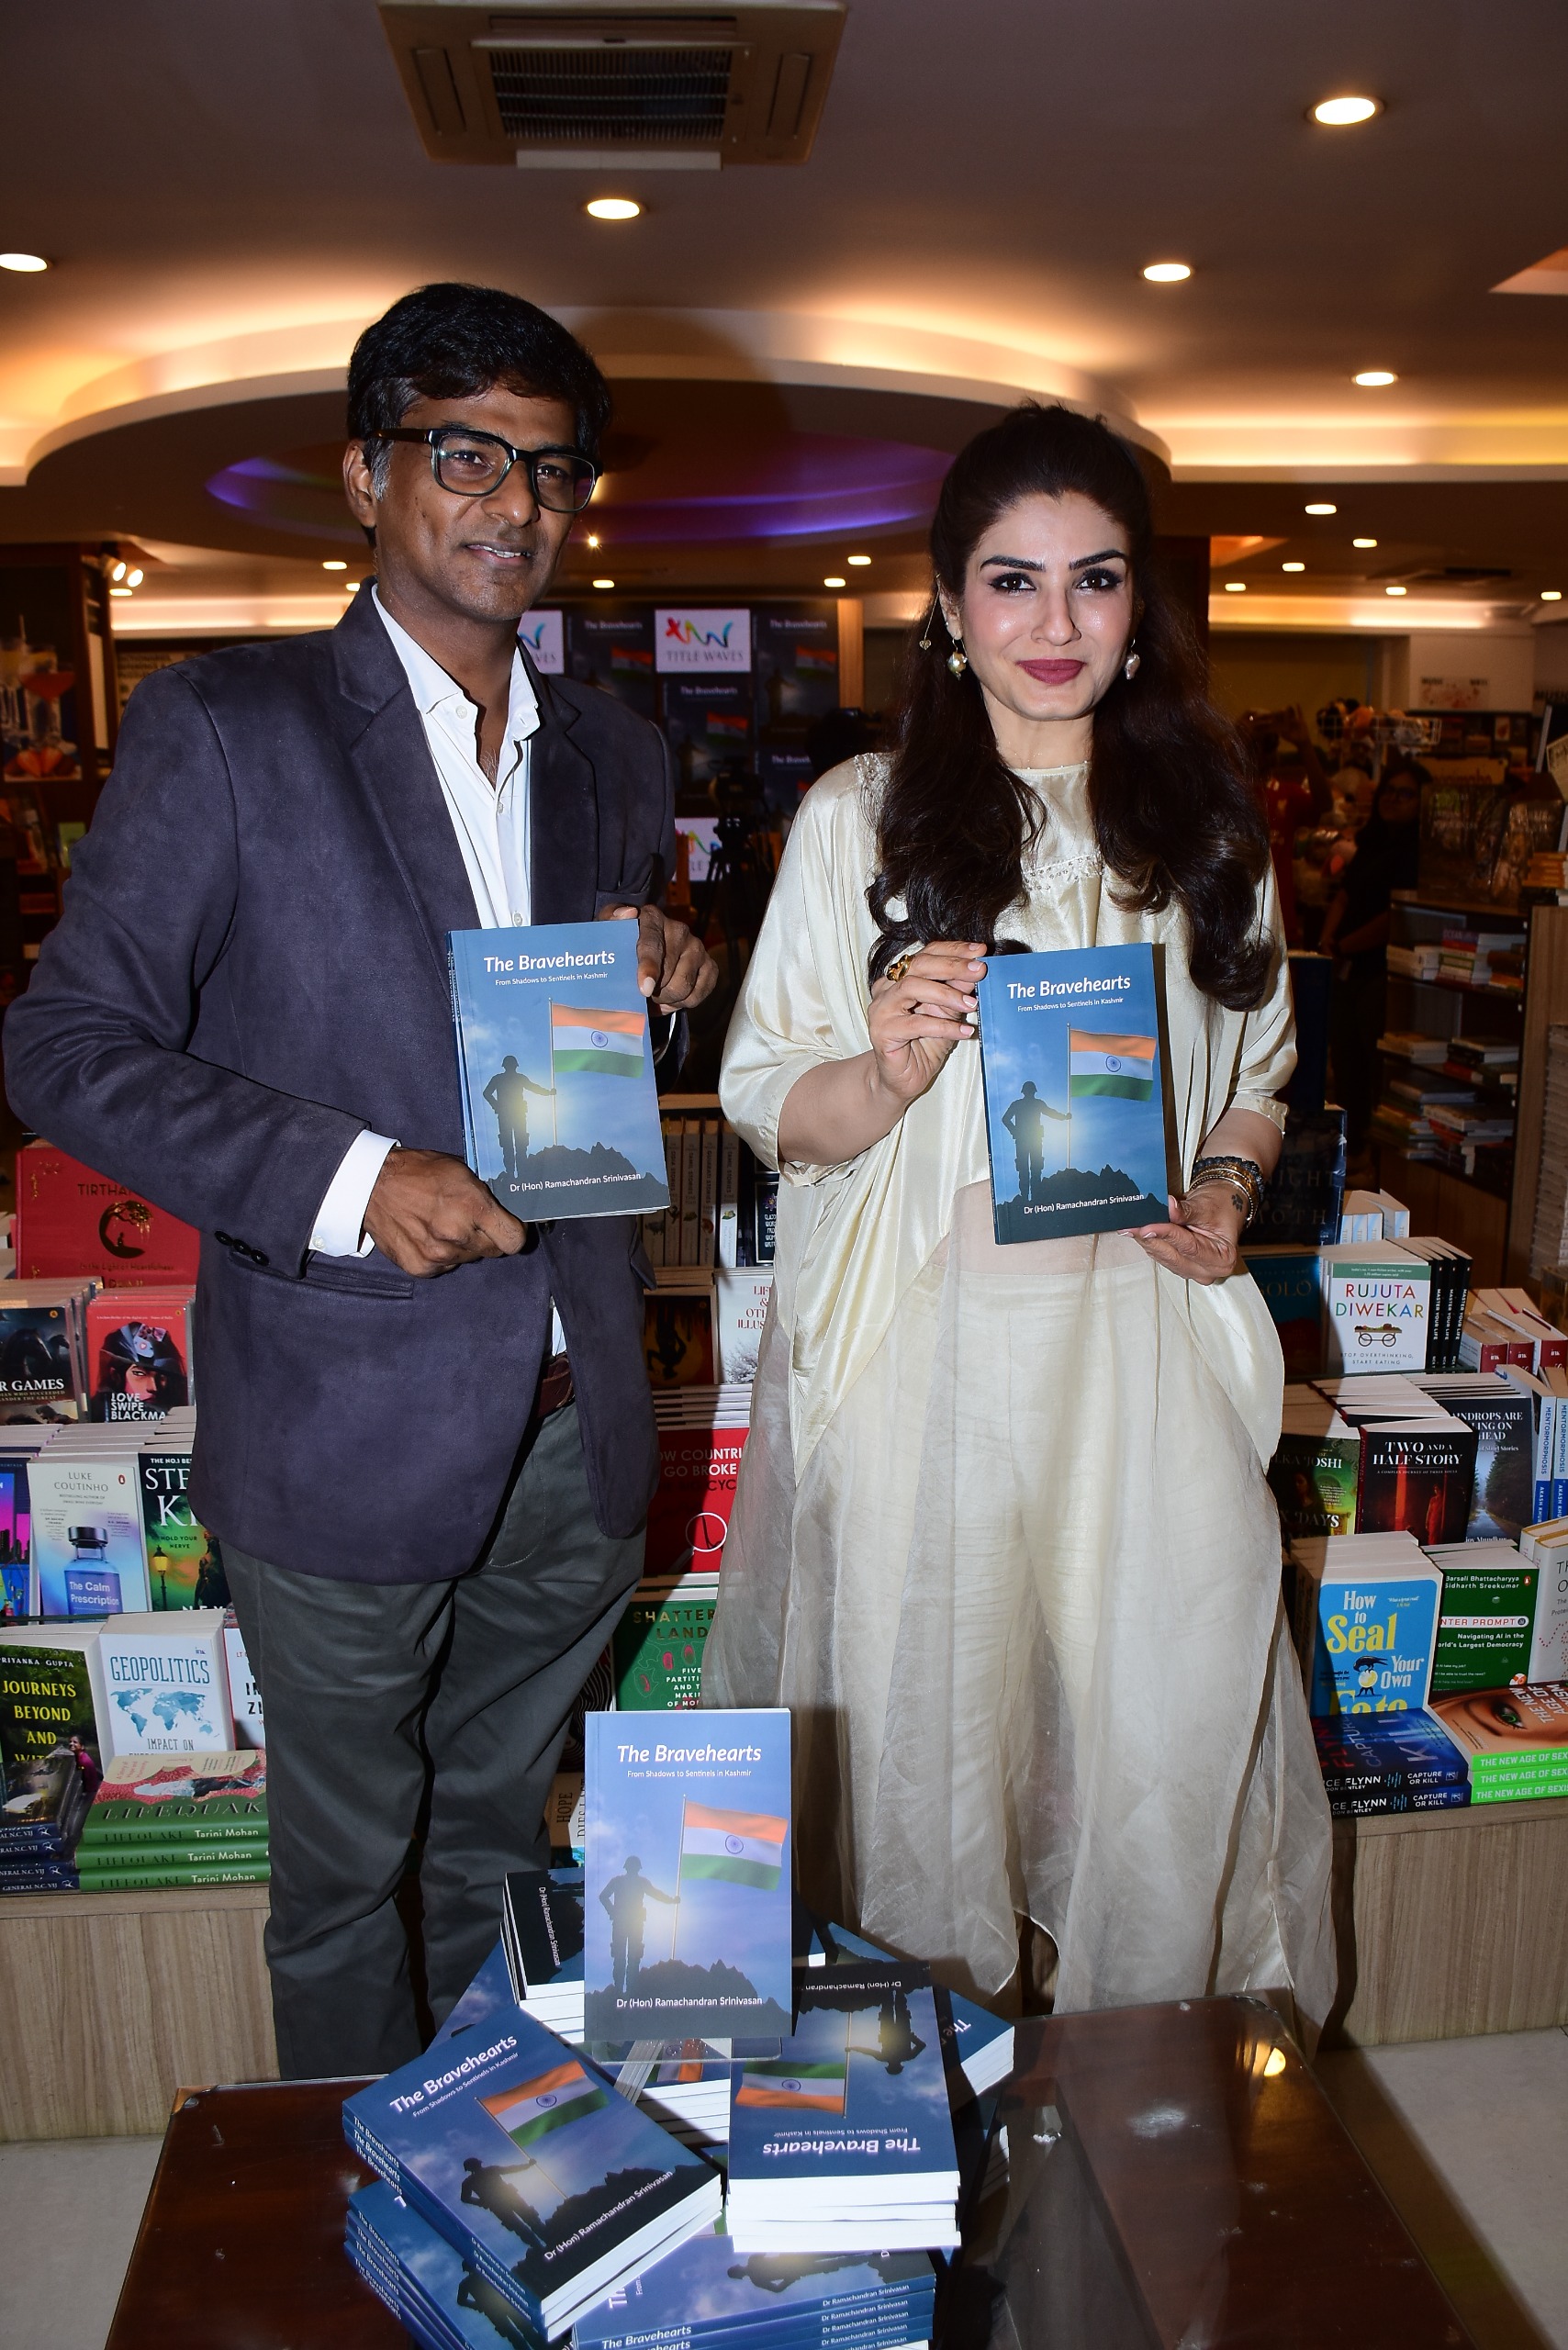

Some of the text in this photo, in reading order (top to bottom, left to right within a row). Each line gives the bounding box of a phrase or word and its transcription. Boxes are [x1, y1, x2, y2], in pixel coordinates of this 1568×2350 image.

[667, 650, 744, 662] TITLE WAVES
[484, 950, 615, 973] The Bravehearts
[512, 977, 540, 985] Shadows
[548, 974, 576, 982] Sentinels
[1007, 975, 1131, 999] The Bravehearts
[1017, 1004, 1033, 1013] From
[1034, 1002, 1059, 1012] Shadows
[1067, 999, 1093, 1008] Sentinels
[1101, 997, 1125, 1005] Kashmir
[510, 1173, 642, 1192] Dr (Hon) Ramachandran Srinivasan
[1024, 1194, 1145, 1214] Dr (Hon) Ramachandran Srinivasan
[1346, 1283, 1416, 1299] RUJUTA
[1336, 1303, 1424, 1318] DIWEKAR
[737, 1319, 766, 1329] ILLUS
[11, 1378, 65, 1392] GAMES
[111, 1393, 140, 1403] LOVE
[111, 1402, 144, 1412] SWIPE
[111, 1411, 166, 1420] BLACKMA
[1503, 1412, 1523, 1421] ARE
[1497, 1422, 1513, 1430] ON
[1478, 1431, 1506, 1440] HEAD
[1540, 1406, 1551, 1474] MENTORMORPHOSIS
[1559, 1404, 1567, 1472] MENTORMORPHOSIS
[1384, 1441, 1424, 1453] TWO
[681, 1448, 743, 1461] COUNTRI
[1372, 1454, 1463, 1465] HALF STORY
[1306, 1456, 1342, 1469] JOSHI
[69, 1472, 92, 1480] LUKE
[664, 1463, 737, 1477] GO BROKE
[54, 1482, 108, 1492] COUTINHO
[69, 1581, 111, 1593] The Calm
[71, 1594, 119, 1607] Prescription
[1343, 1590, 1377, 1611] How
[1354, 1611, 1367, 1624] to
[1327, 1612, 1398, 1653] Seal
[0, 1657, 74, 1668] RIYANKA GUPTA
[1391, 1654, 1425, 1673] Your
[110, 1656, 210, 1684] GEOPOLITICS
[1380, 1671, 1412, 1689] Own
[2, 1680, 77, 1697] JOURNEYS
[14, 1705, 72, 1721] BEYOND
[27, 1731, 57, 1745] AND
[147, 1738, 195, 1751] IMPACT ON
[618, 1743, 762, 1762] The Bravehearts
[1481, 1753, 1550, 1766] THE NEW AGE OF
[627, 1770, 644, 1778] From
[645, 1769, 676, 1778] Shadows
[685, 1769, 716, 1778] Sentinels
[724, 1769, 752, 1777] Kashmir
[1345, 1775, 1381, 1785] FLYNN
[1407, 1771, 1442, 1779] CAPTURE
[1351, 1798, 1386, 1808] FLYNN
[1413, 1792, 1448, 1801] CAPTURE
[194, 1827, 259, 1839] Tarini Mohan
[187, 1851, 252, 1862] Tarini Mohan
[805, 1982, 865, 1991] Ramachandran
[867, 1981, 890, 1989] (Hon)
[616, 1997, 763, 2009] Dr (Hon) Ramachandran Srinivasan
[389, 2034, 518, 2114] The Bravehearts
[354, 2115, 400, 2169] The Bravehearts
[762, 2136, 921, 2156] The Bravehearts
[543, 2169, 674, 2261] Dr (Hon) Ramachandran Srinivasan
[832, 2291, 878, 2305] Ramachandran
[878, 2285, 910, 2295] Srinivasan
[602, 2325, 692, 2350] The Bravehearts
